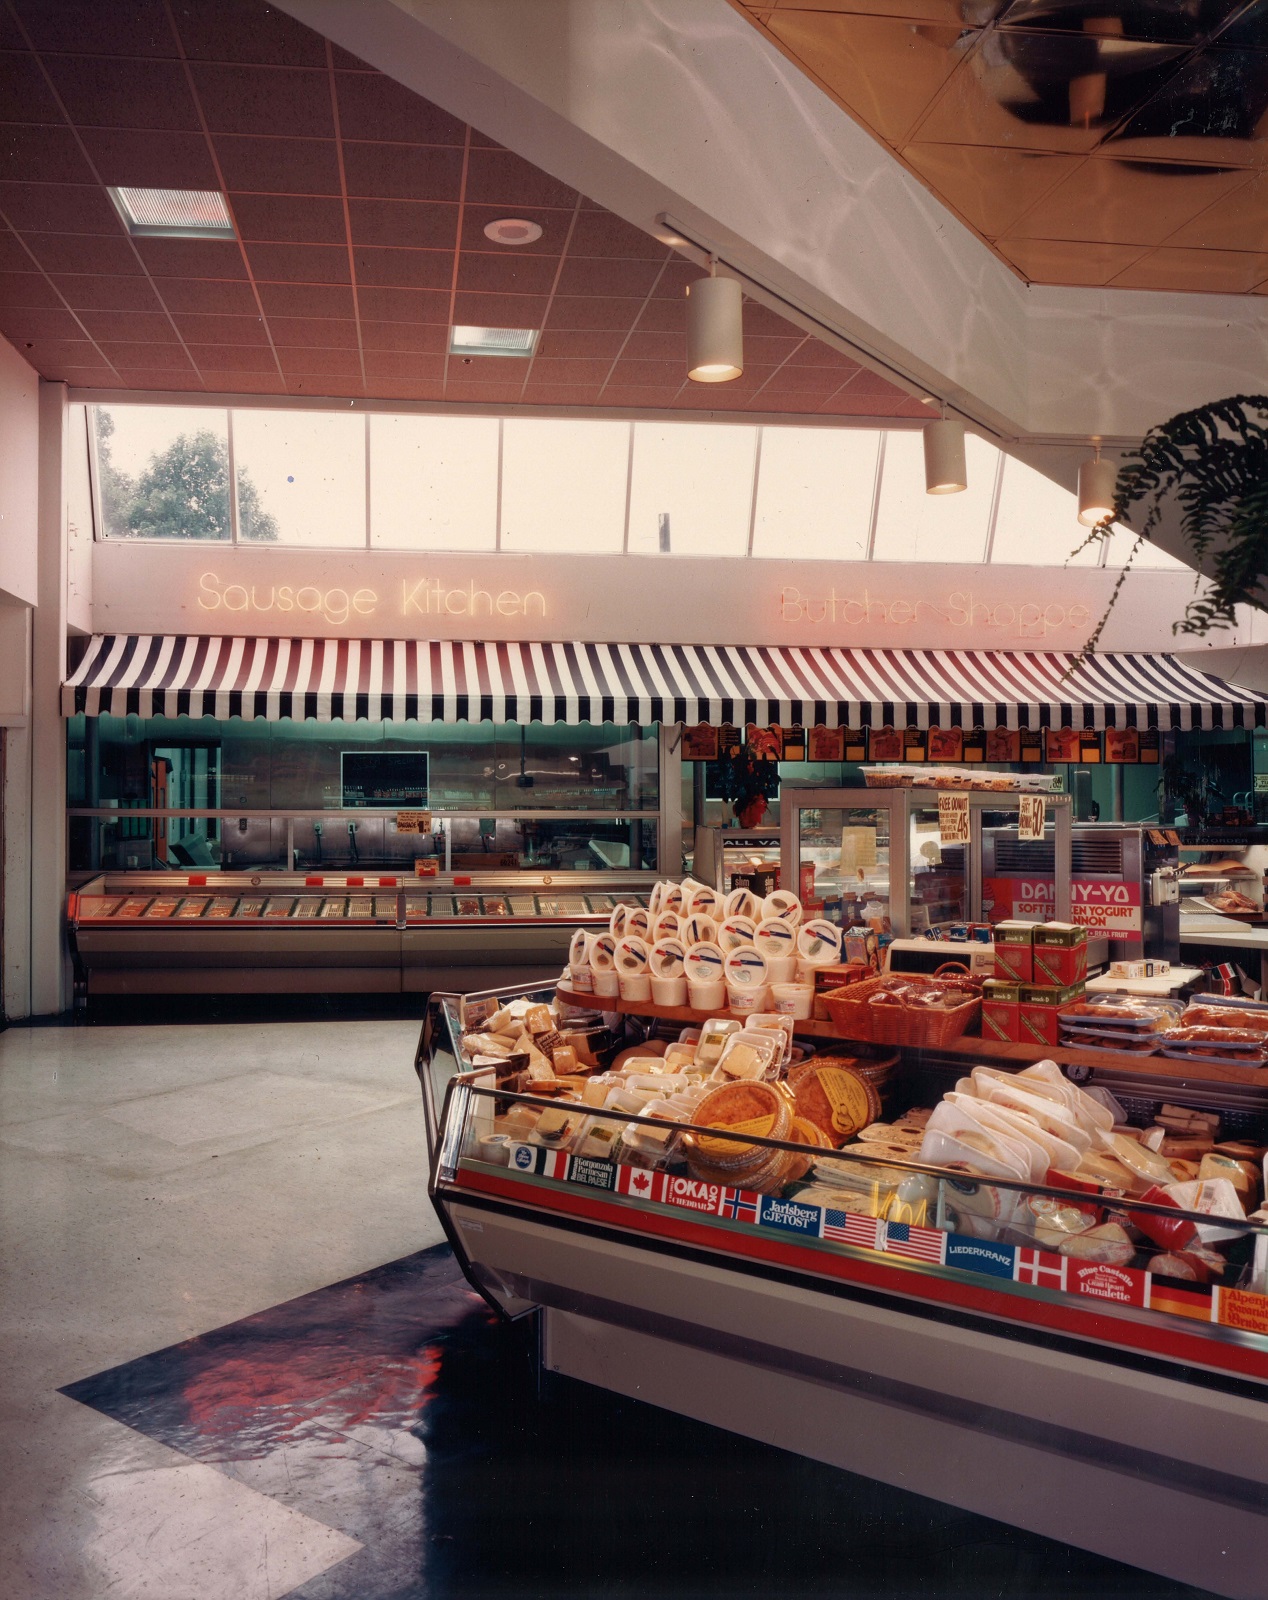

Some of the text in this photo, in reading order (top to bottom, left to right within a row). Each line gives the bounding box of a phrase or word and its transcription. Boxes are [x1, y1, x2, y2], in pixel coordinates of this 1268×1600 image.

[197, 572, 546, 625] Sausage Kitchen
[781, 586, 1090, 638] Butcher Shoppe
[939, 797, 951, 811] FREE
[1018, 903, 1134, 918] SOFT FREN YOGURT
[1071, 915, 1107, 927] NNON
[1111, 931, 1129, 939] FRUIT
[578, 1157, 613, 1172] Gorgonzola
[578, 1165, 608, 1179] Parmesan
[577, 1173, 588, 1183] BEL
[588, 1175, 608, 1188] PAESE
[673, 1178, 709, 1200] OKA
[671, 1197, 707, 1211] CHEDDAR
[707, 1185, 718, 1211] OKA
[763, 1210, 810, 1229] GJETOST
[769, 1200, 818, 1222] Jarlsberg
[949, 1246, 1012, 1266] LIEDERKRANZ
[1077, 1265, 1134, 1287] Blue Castello
[1080, 1282, 1131, 1302] Danalette
